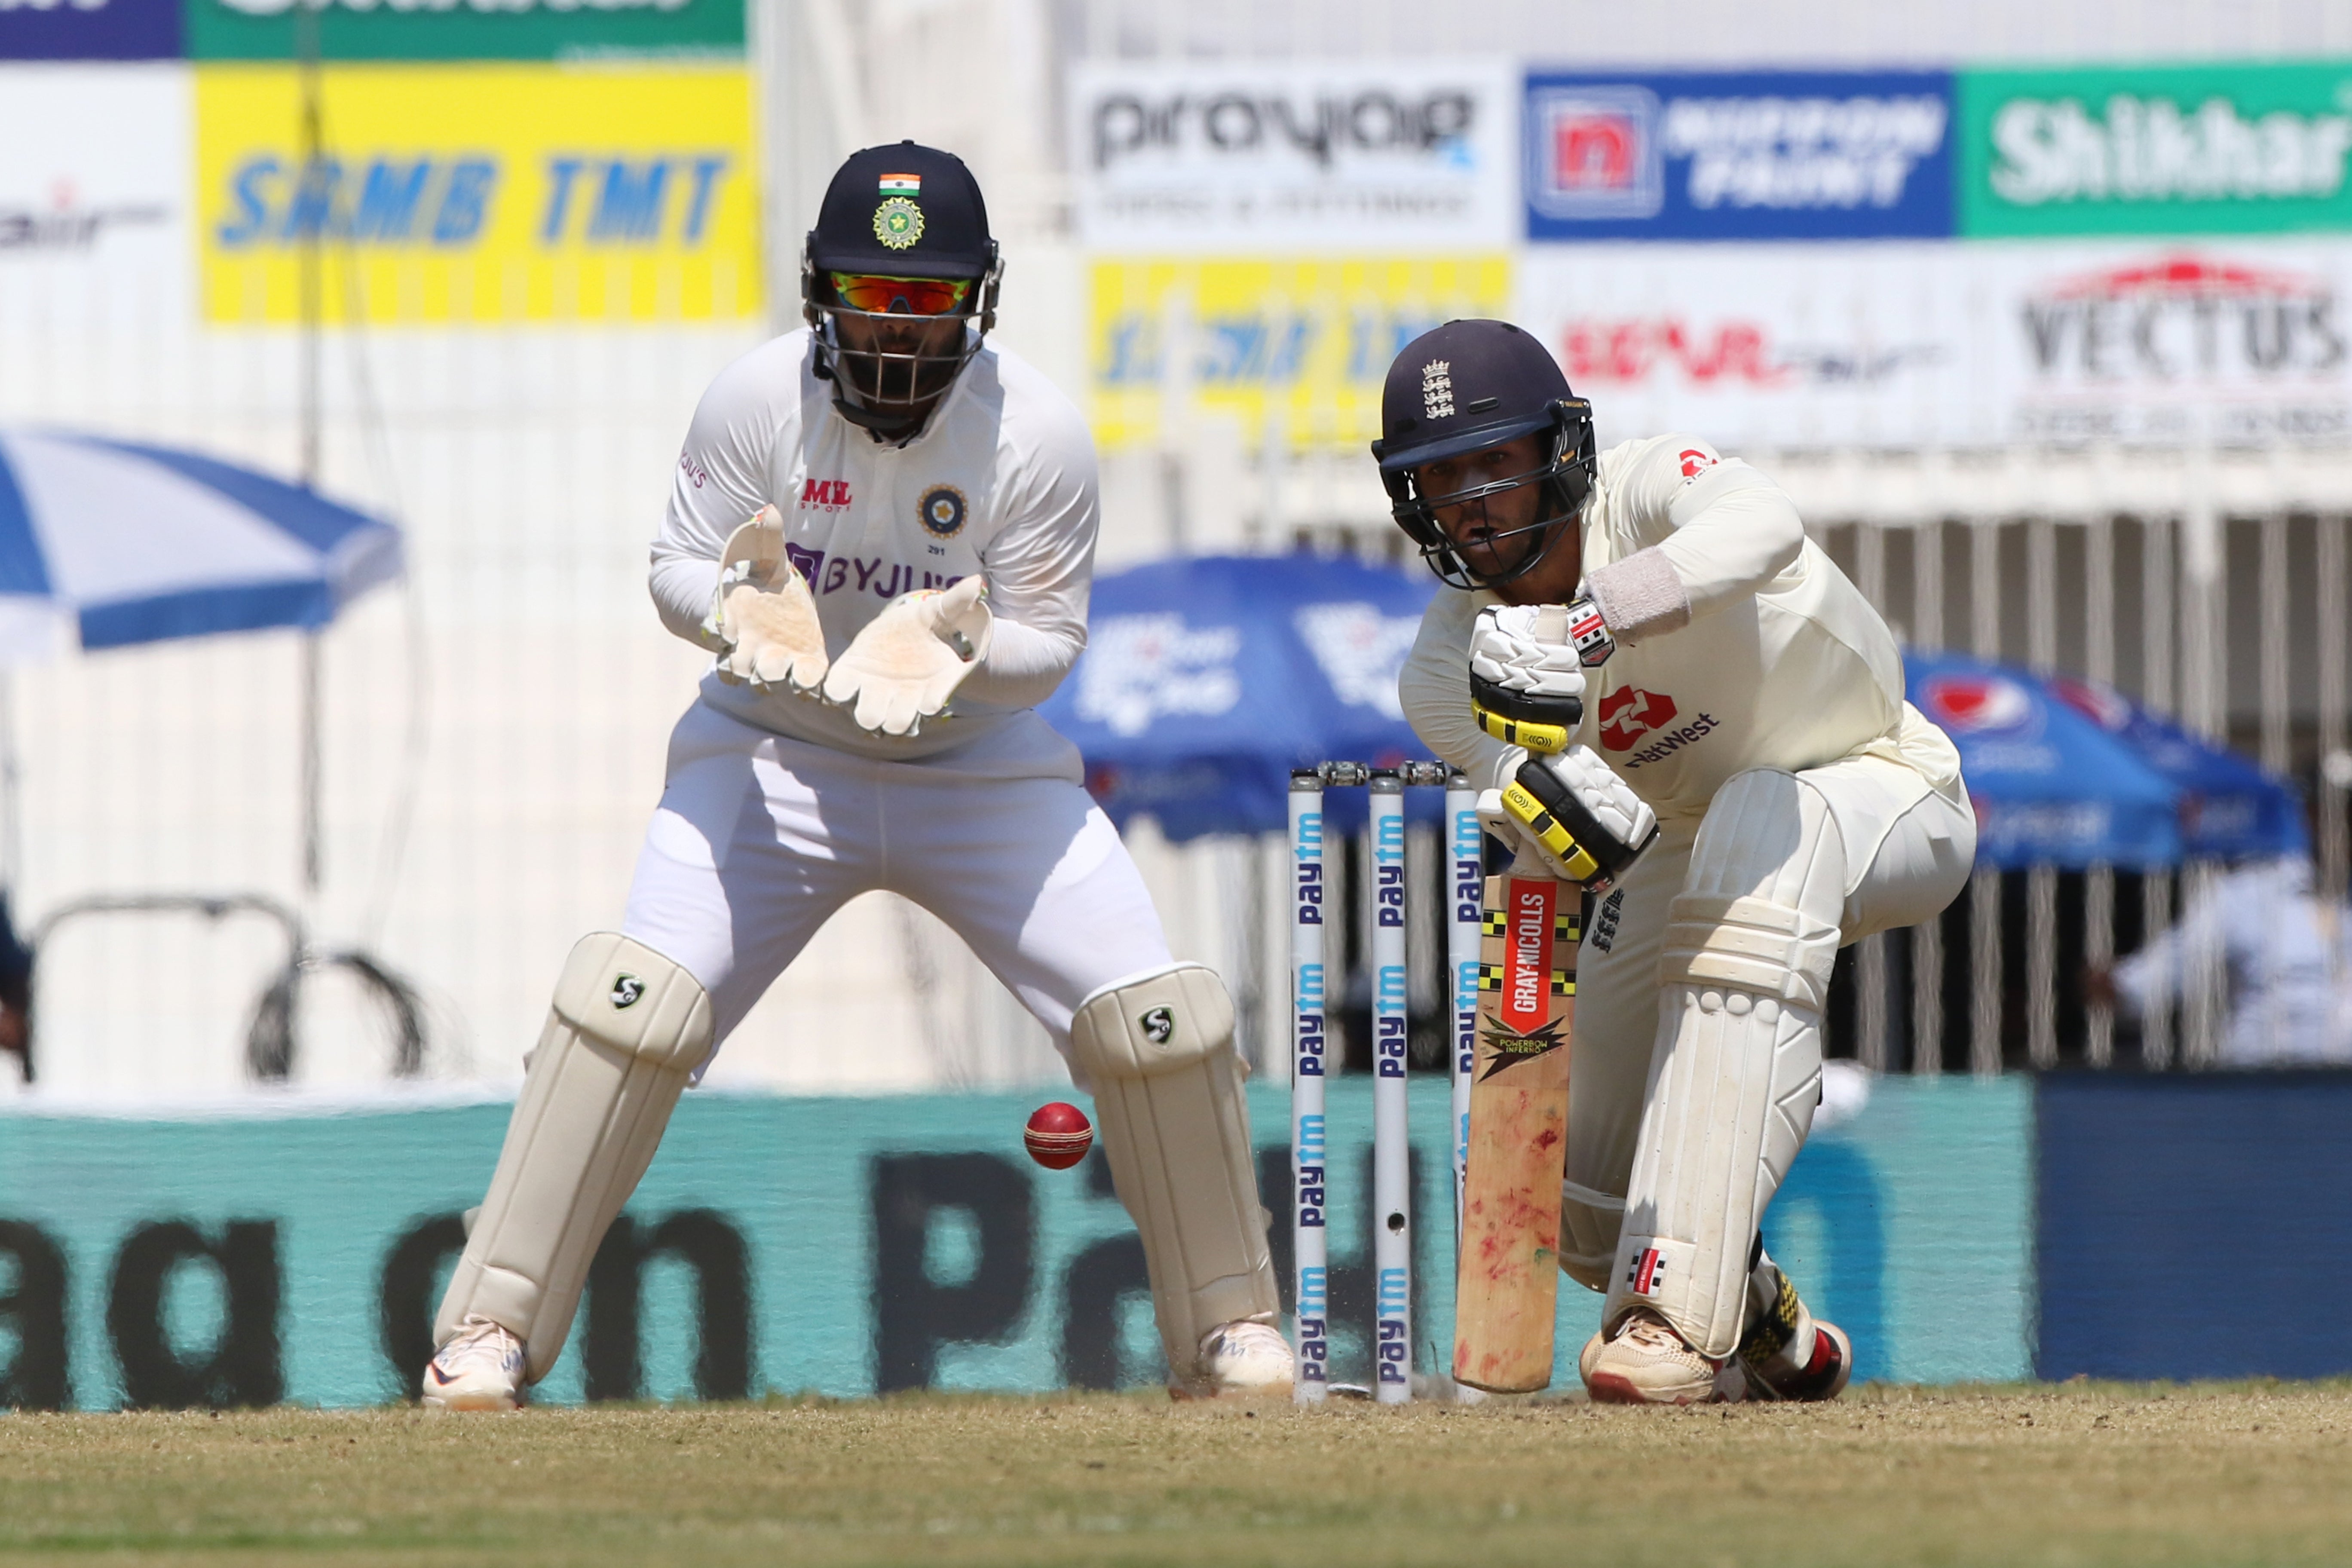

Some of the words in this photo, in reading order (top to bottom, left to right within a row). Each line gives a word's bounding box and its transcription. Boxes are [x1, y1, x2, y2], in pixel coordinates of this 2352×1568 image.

[535, 153, 733, 249] TMT
[2016, 294, 2349, 374] VECTUS
[1500, 1038, 1547, 1048] POWERBOW
